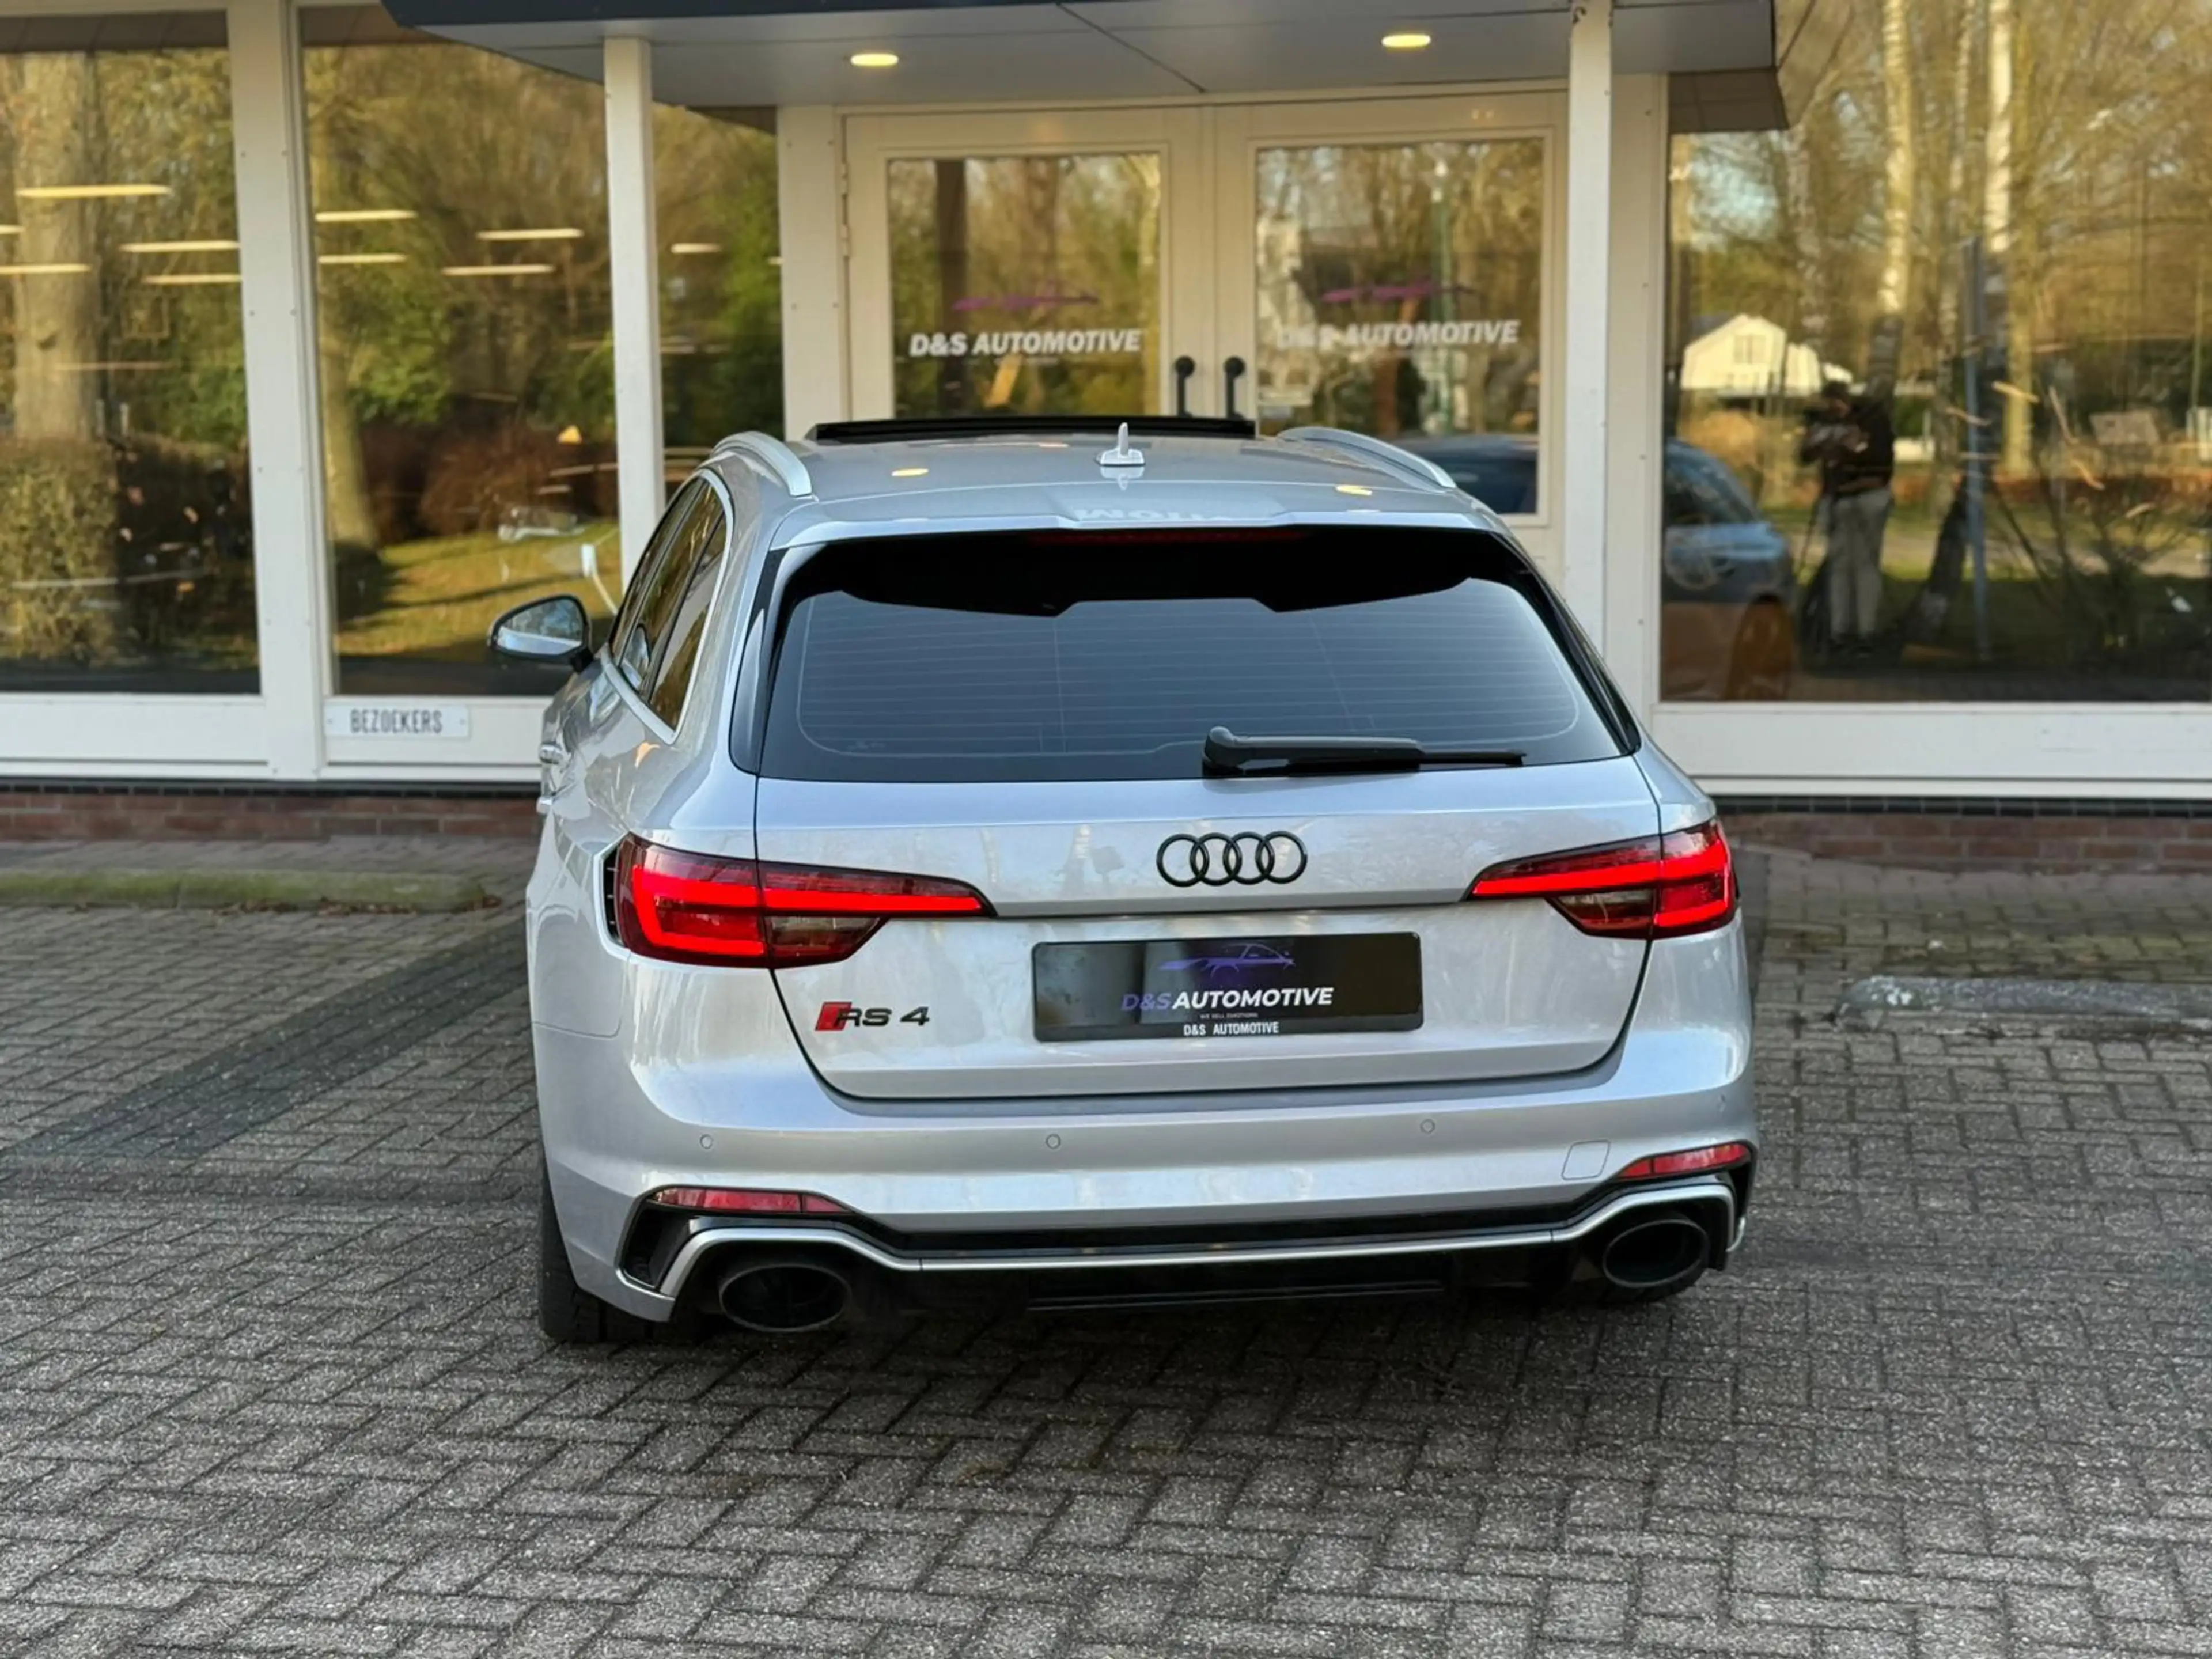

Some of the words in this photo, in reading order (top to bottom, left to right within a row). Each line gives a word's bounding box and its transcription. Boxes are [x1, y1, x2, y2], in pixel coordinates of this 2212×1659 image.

[910, 334, 968, 357] D&S
[972, 329, 1141, 355] AUTOMOTIVE
[1343, 320, 1520, 347] AUTOMOTIVE
[350, 709, 443, 734] BEZOEKERS
[830, 1006, 892, 1028] RS
[900, 1006, 930, 1027] 4
[1183, 1024, 1206, 1036] D&S
[1213, 1021, 1279, 1035] AUTOMOTIVE
